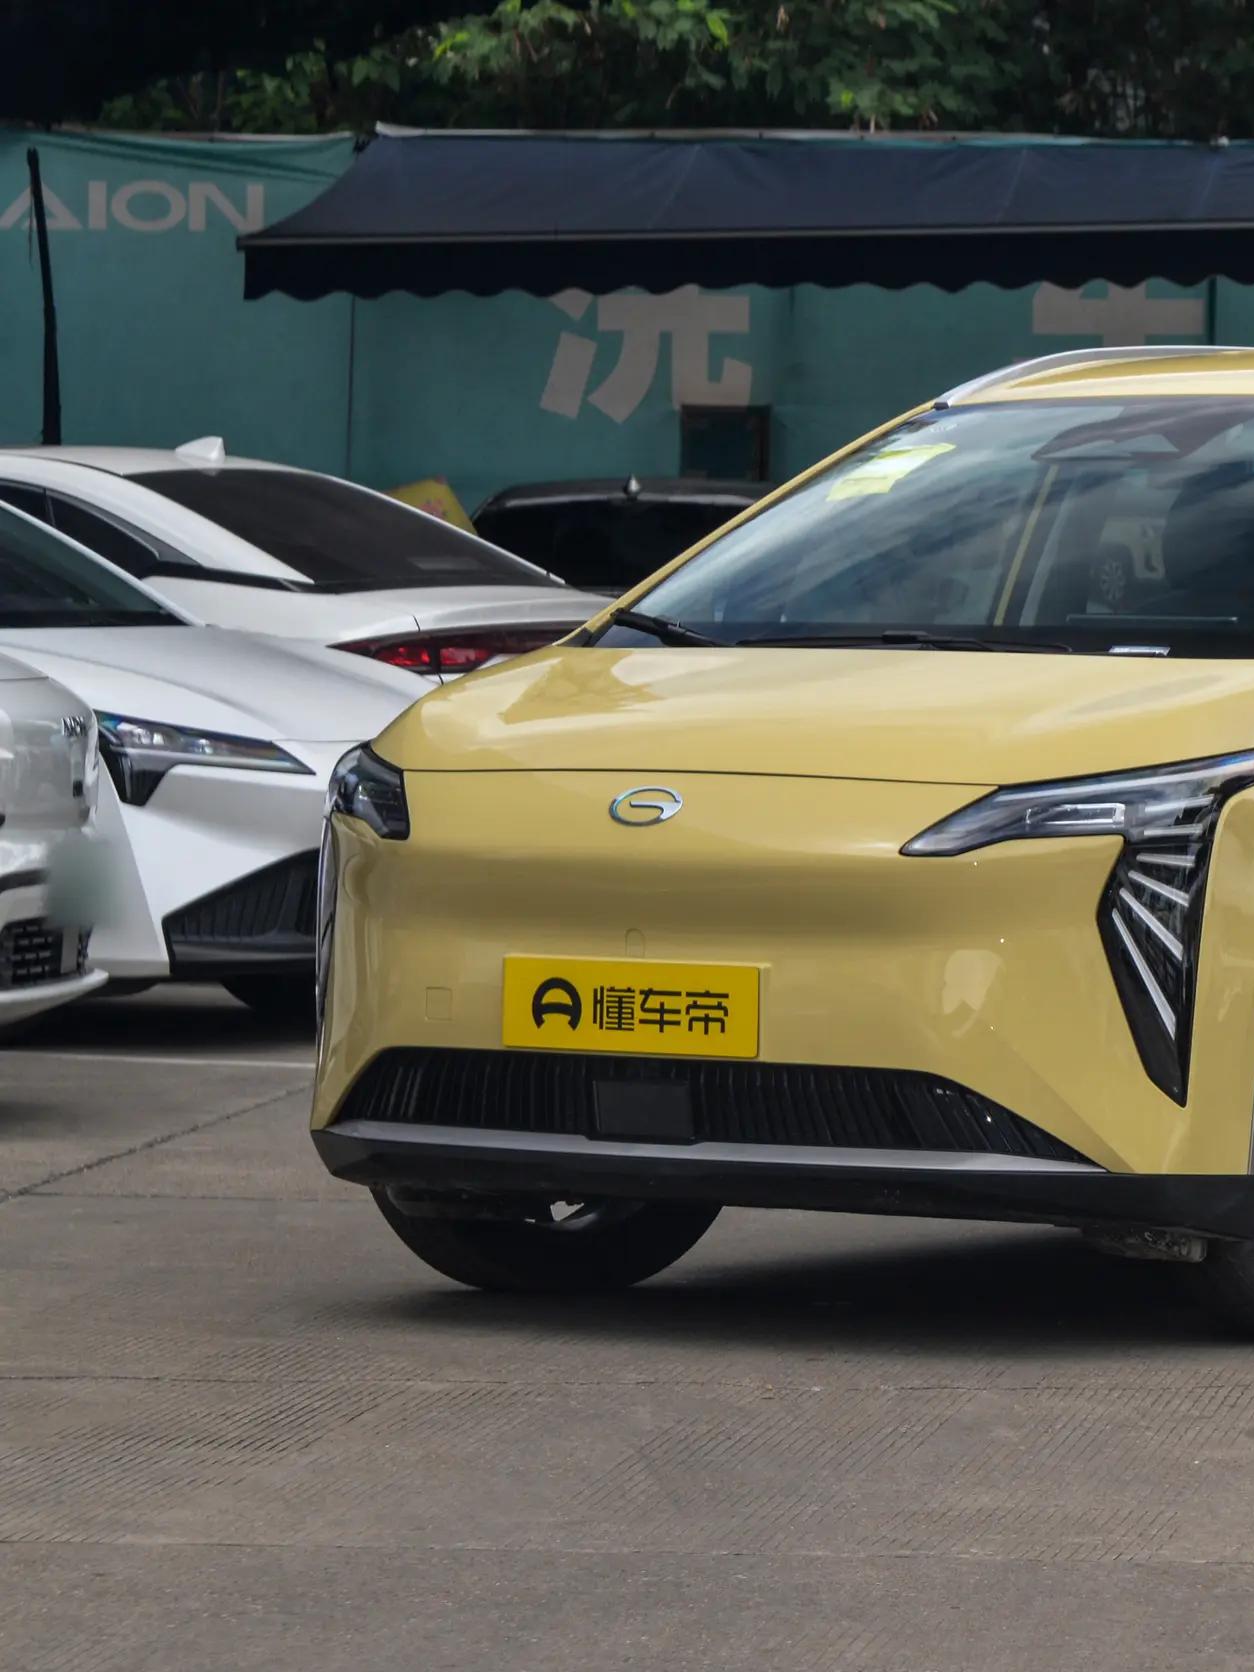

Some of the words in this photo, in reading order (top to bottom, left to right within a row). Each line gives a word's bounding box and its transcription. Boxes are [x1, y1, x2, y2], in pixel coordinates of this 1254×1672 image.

[0, 180, 264, 231] AION
[592, 984, 730, 1036] 懂车帝
